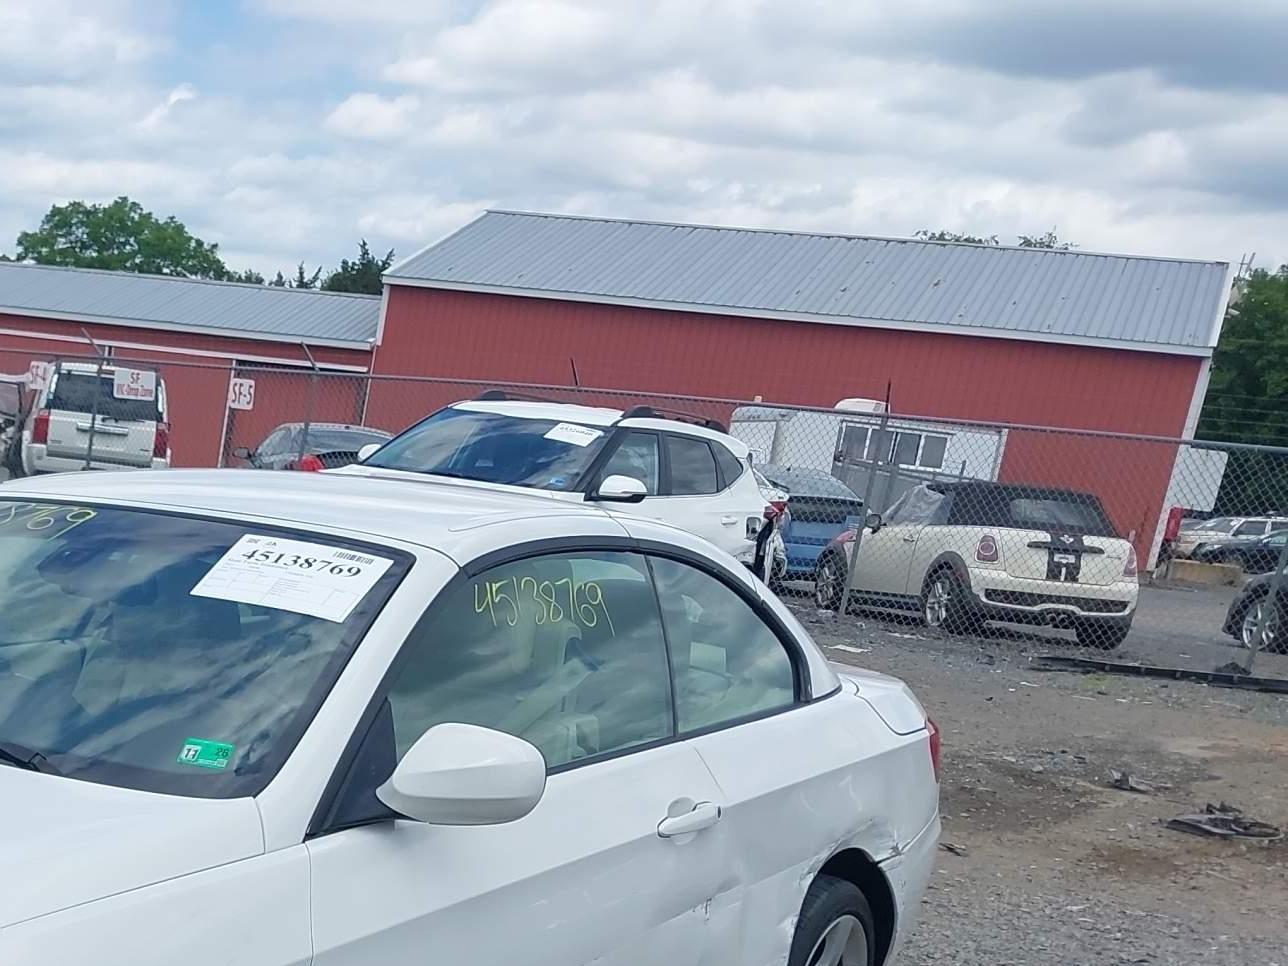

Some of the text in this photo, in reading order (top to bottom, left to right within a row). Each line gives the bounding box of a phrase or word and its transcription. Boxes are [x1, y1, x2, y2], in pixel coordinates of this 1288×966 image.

[130, 372, 141, 385] SF
[232, 383, 253, 406] SF-5
[242, 549, 362, 577] 45138769
[474, 576, 616, 637] 45138769
